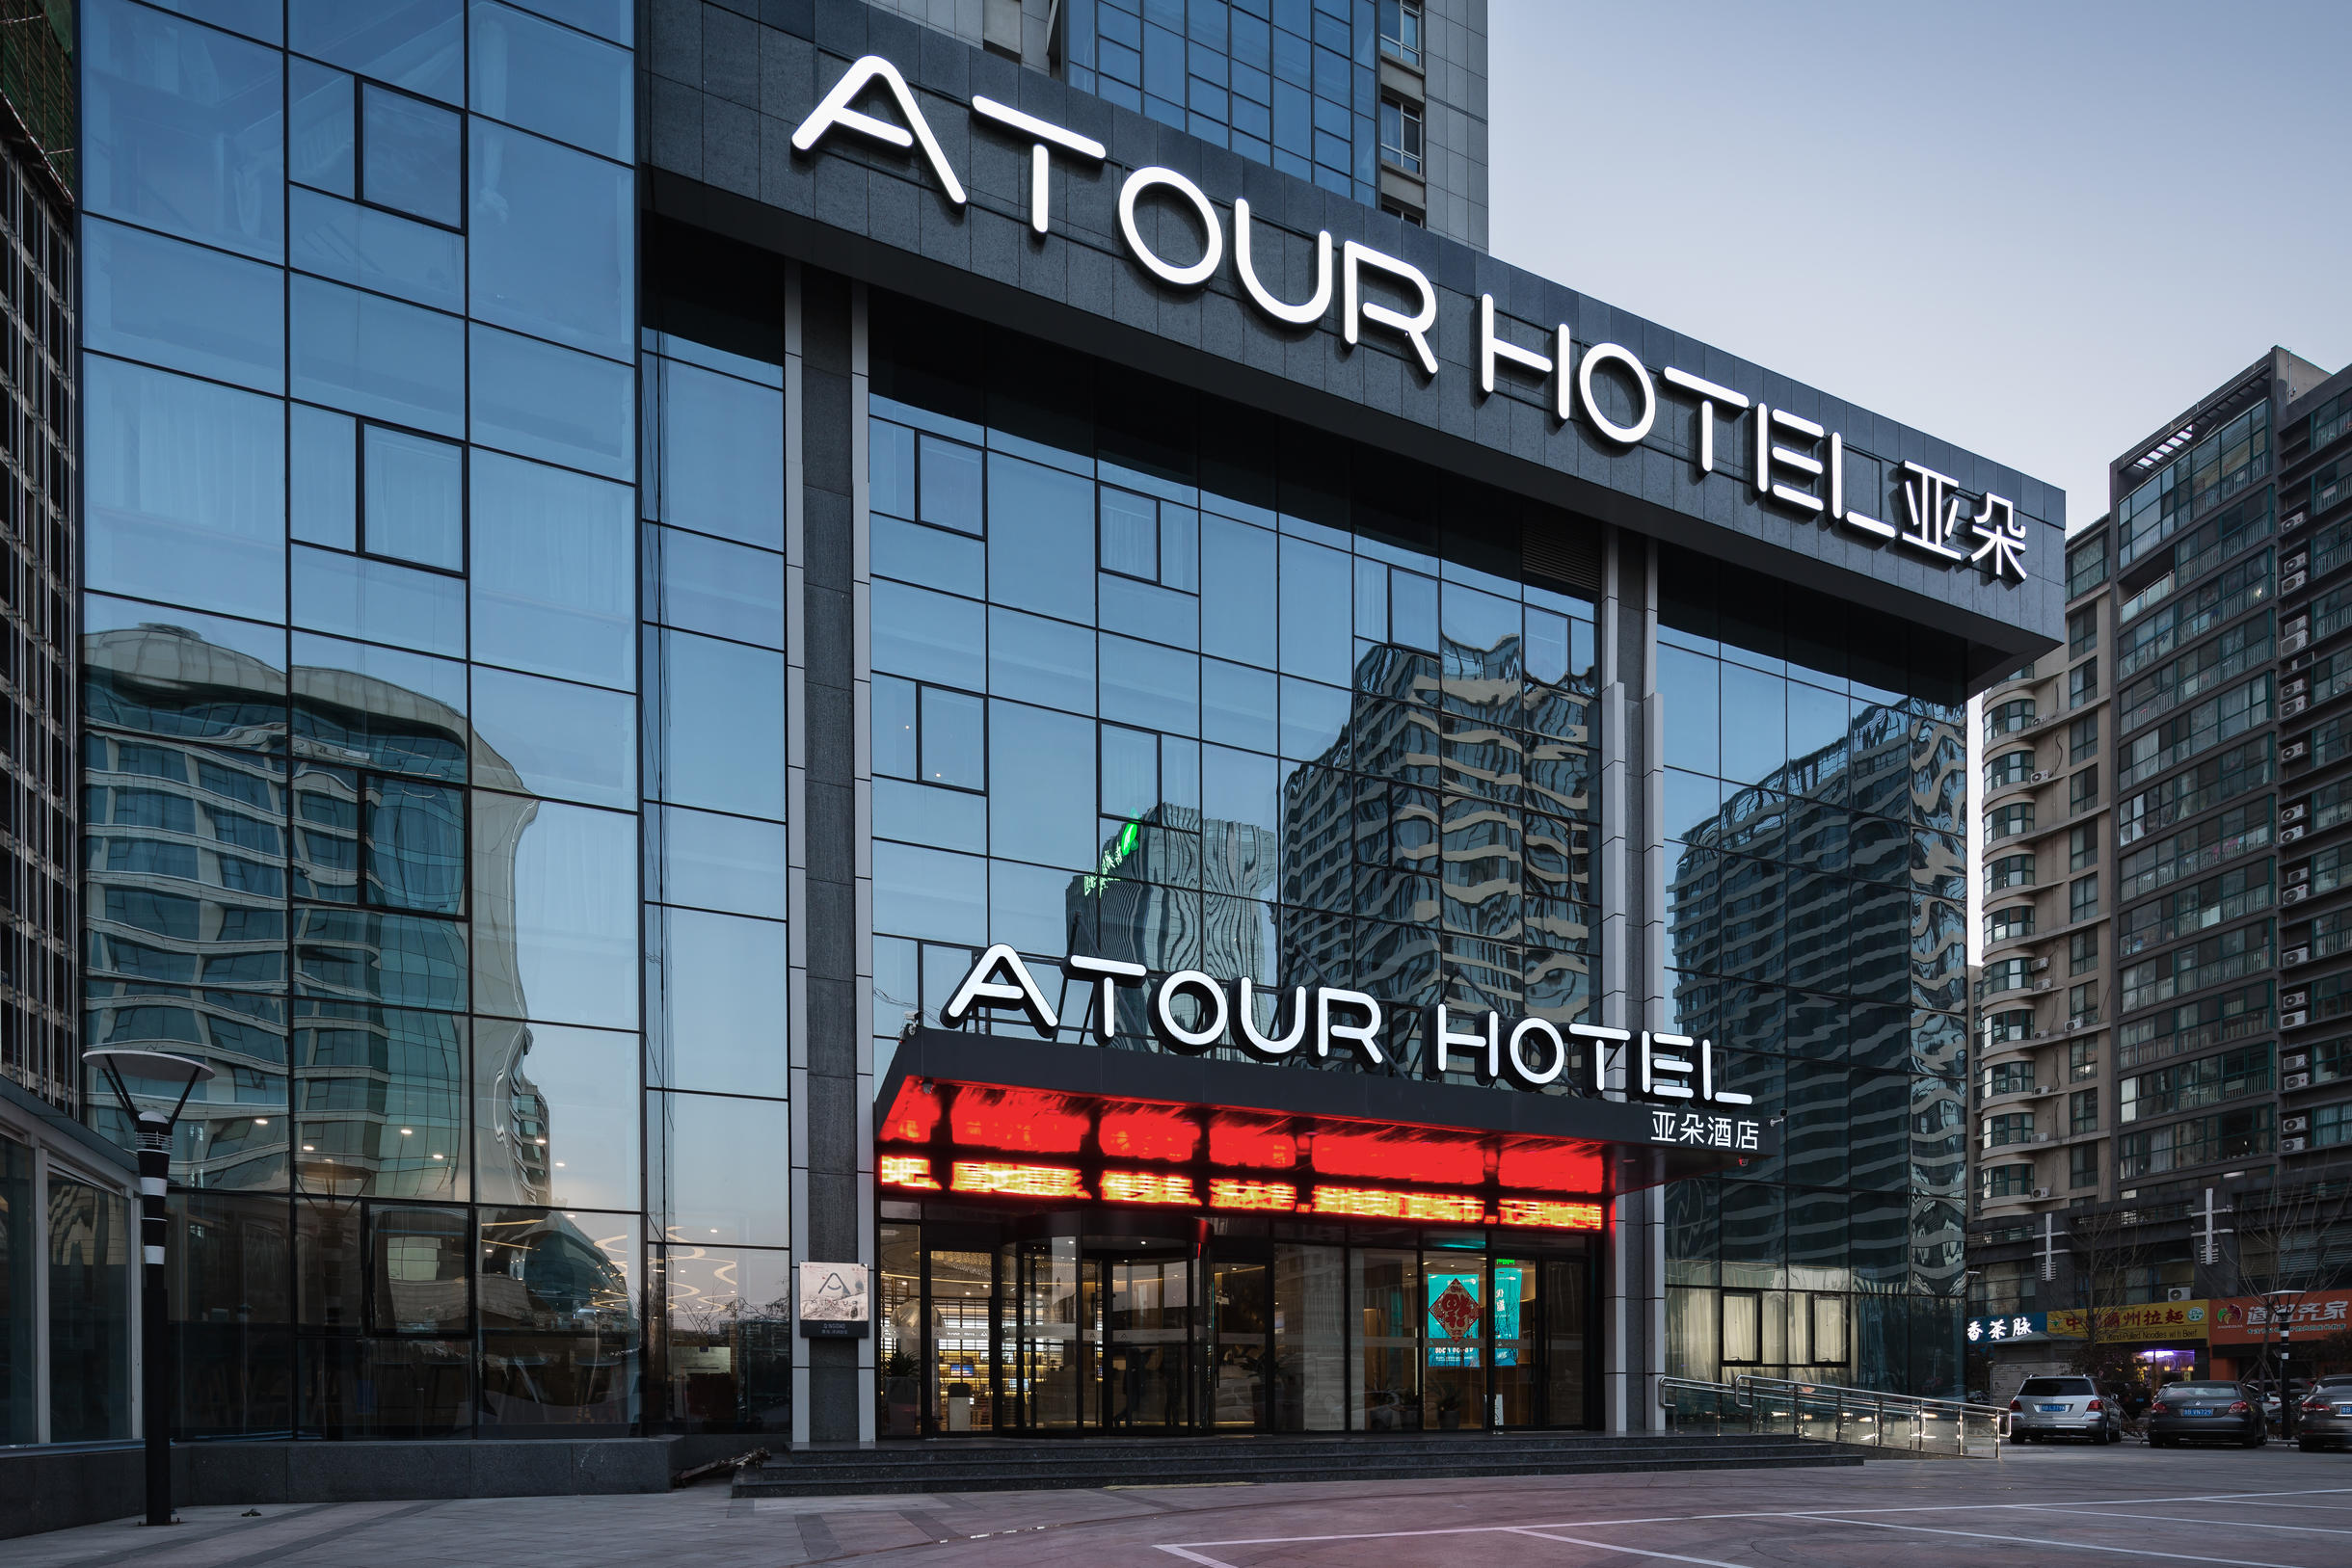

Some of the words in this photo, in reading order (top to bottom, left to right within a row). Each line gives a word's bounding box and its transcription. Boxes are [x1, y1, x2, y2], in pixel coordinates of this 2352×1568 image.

[791, 55, 1439, 374] ATOUR
[1482, 293, 1896, 539] HOTEL
[1901, 459, 2028, 580] 亚朵
[948, 943, 1384, 1064] ATOUR
[1436, 1003, 1752, 1105] HOTEL
[1650, 1110, 1760, 1151] 亚朵酒店
[2142, 1329, 2167, 1339] Noodles
[2182, 1328, 2198, 1338] Beef
